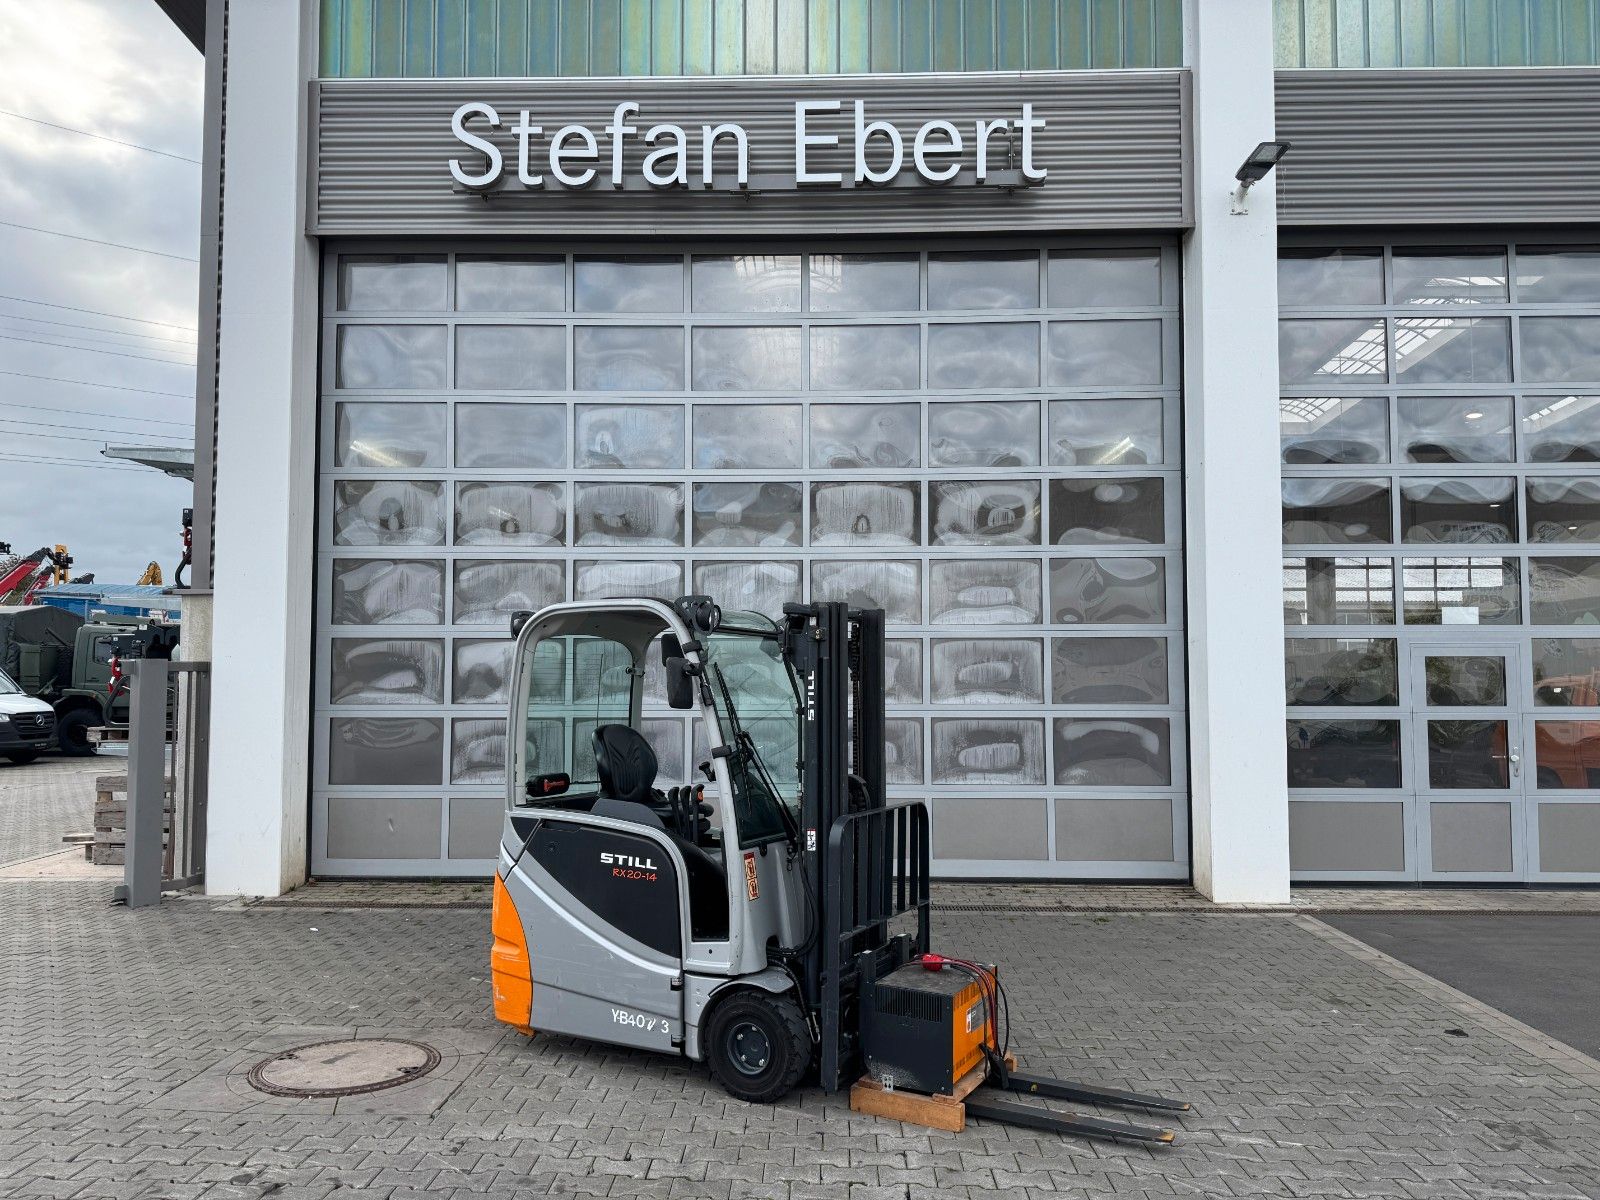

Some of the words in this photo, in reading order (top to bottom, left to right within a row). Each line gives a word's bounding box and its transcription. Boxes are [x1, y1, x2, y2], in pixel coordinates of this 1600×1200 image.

[448, 102, 750, 187] Stefan
[794, 99, 1048, 186] Ebert
[807, 670, 815, 721] STILL
[600, 852, 658, 870] STILL
[612, 867, 658, 882] RX20-14
